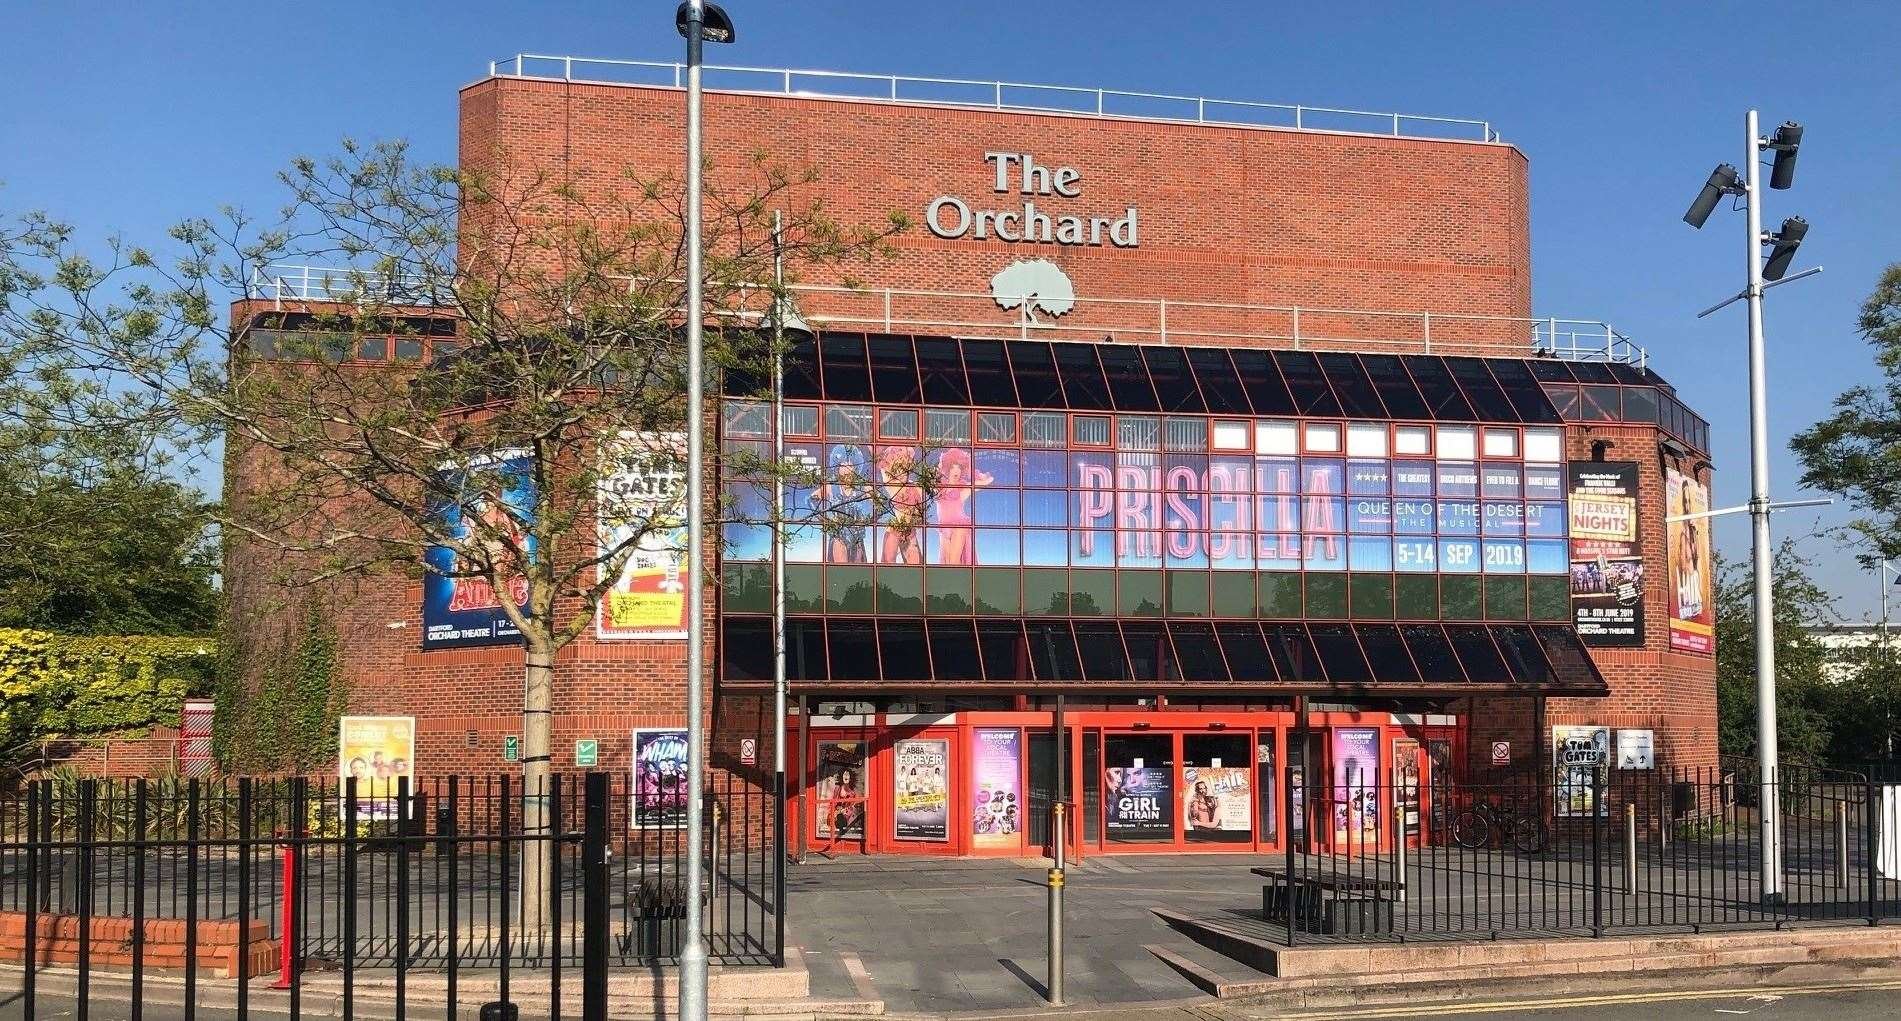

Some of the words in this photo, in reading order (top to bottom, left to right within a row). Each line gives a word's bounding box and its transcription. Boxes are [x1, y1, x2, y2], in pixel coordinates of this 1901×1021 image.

[984, 151, 1081, 198] The
[926, 196, 1139, 248] Orchard
[1079, 464, 1338, 560] PRISCILLA
[1357, 501, 1415, 515] QUEEN
[1420, 503, 1447, 516] OF
[1451, 503, 1480, 517] THE
[1486, 504, 1544, 518] DESERT
[1581, 502, 1626, 515] JERSEY
[1401, 518, 1426, 527] THE
[1438, 519, 1500, 529] MUSICAL
[1574, 514, 1628, 532] NIGHTS
[1398, 542, 1435, 564] 5-14
[1446, 543, 1474, 565] SEP
[1486, 545, 1523, 566] 2019
[1620, 608, 1634, 617] 2019
[428, 630, 461, 641] ORCHARD
[461, 627, 491, 639] THEATRE
[906, 746, 925, 755] ABBA
[1565, 750, 1598, 762] GATES
[1118, 797, 1160, 811] GIRL
[1128, 811, 1160, 820] TRAIN
